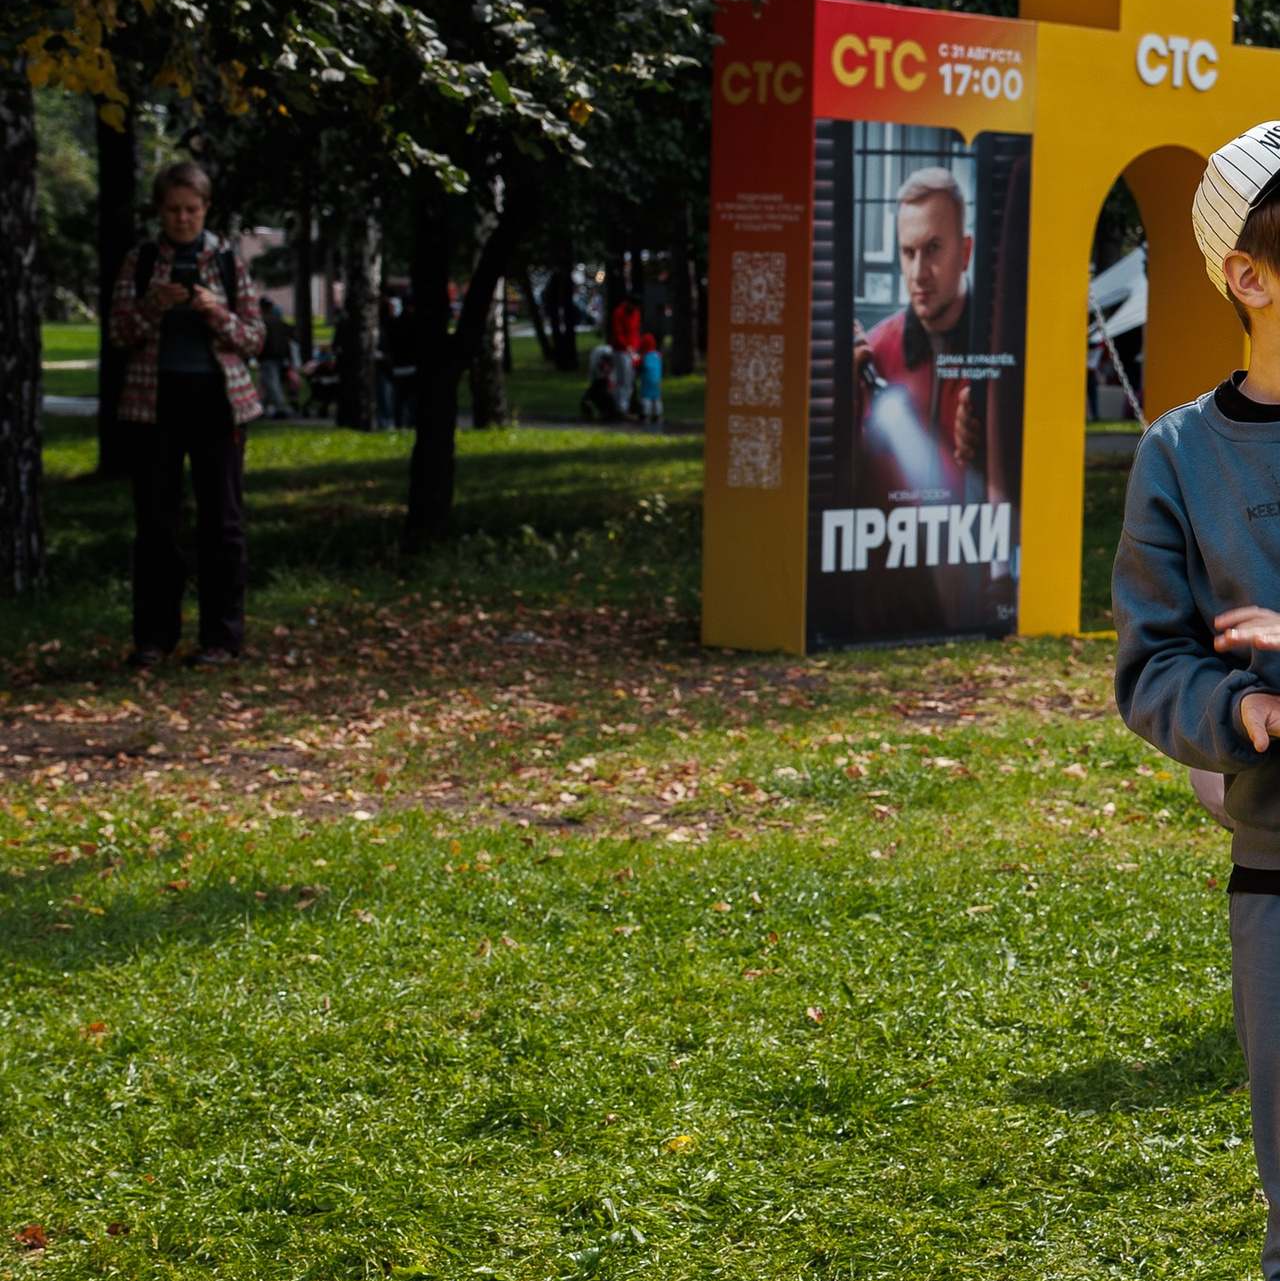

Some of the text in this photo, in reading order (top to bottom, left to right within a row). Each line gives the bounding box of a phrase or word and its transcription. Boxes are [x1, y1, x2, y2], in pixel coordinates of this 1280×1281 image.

[721, 61, 804, 105] СТС
[832, 34, 927, 93] СТС
[939, 63, 1023, 101] 17:00
[1137, 33, 1218, 91] СТС
[821, 503, 1011, 573] ПРЯТКИ
